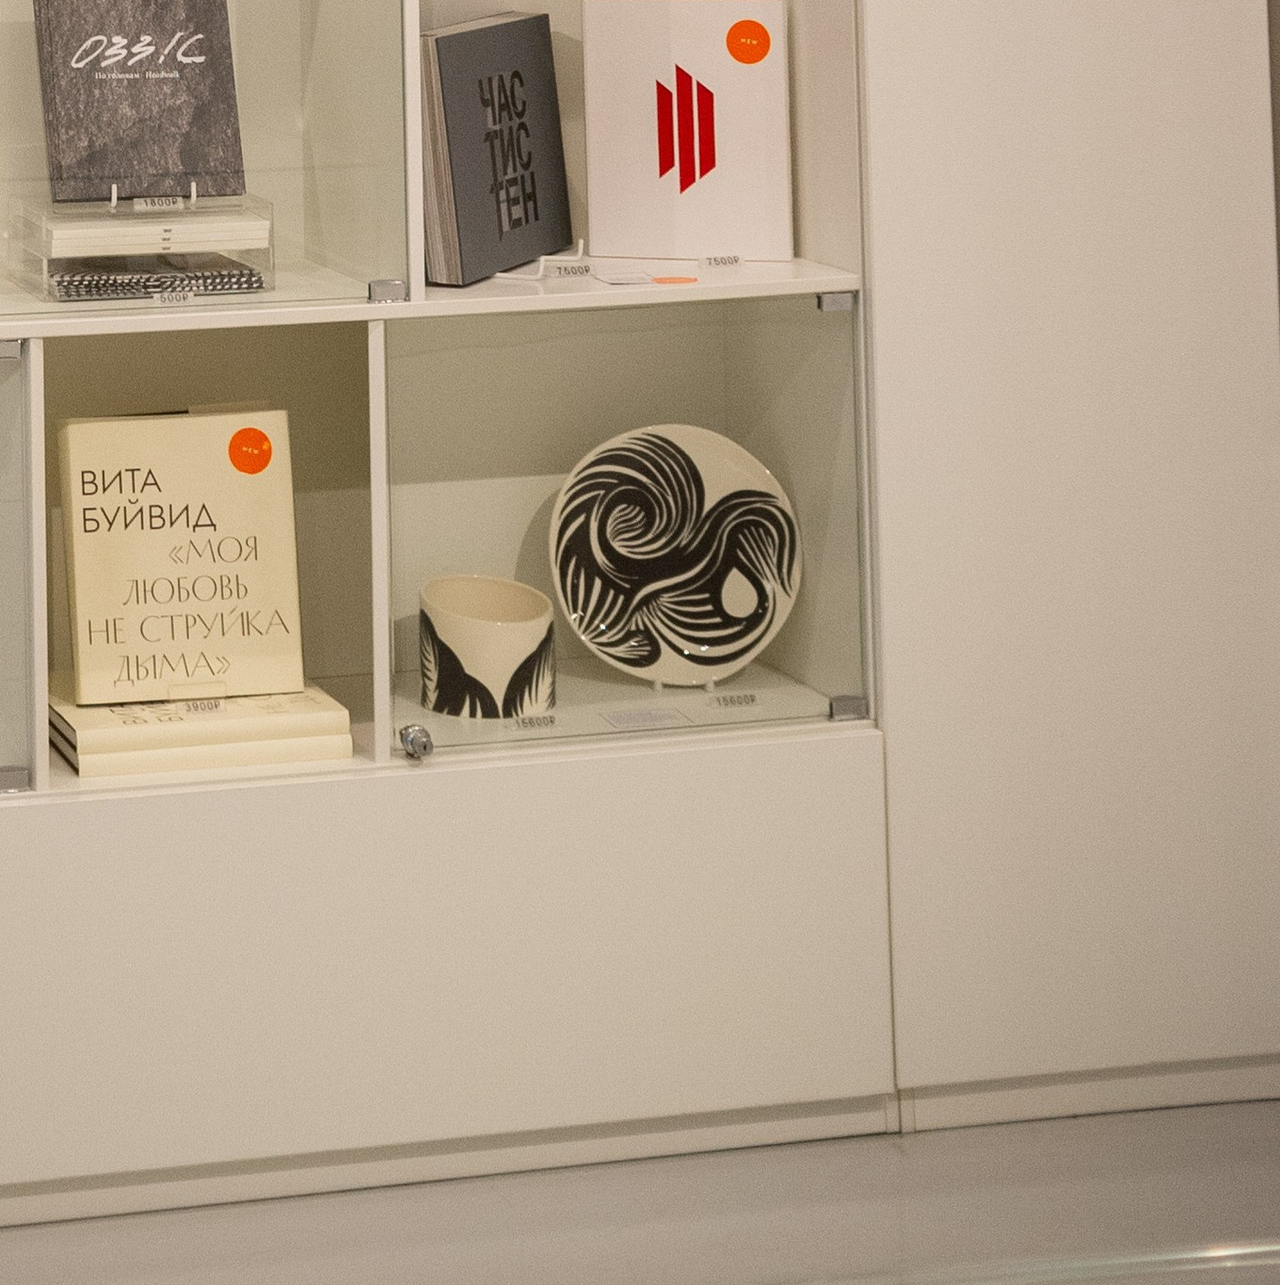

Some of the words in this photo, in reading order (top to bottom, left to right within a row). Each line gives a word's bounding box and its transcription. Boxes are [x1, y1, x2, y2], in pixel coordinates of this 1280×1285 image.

[478, 70, 527, 127] ЧАС
[484, 122, 532, 185] ТИС
[489, 172, 540, 241] ТЕН
[81, 468, 162, 496] ВИТА
[83, 499, 217, 533] БУЙВИД
[169, 536, 258, 564] «МОЯ
[123, 574, 248, 606] ЛЮБОВЬ
[88, 618, 126, 645] НЕ
[140, 606, 290, 643] СТРУЙКА
[113, 651, 231, 687] ДЫМА»
